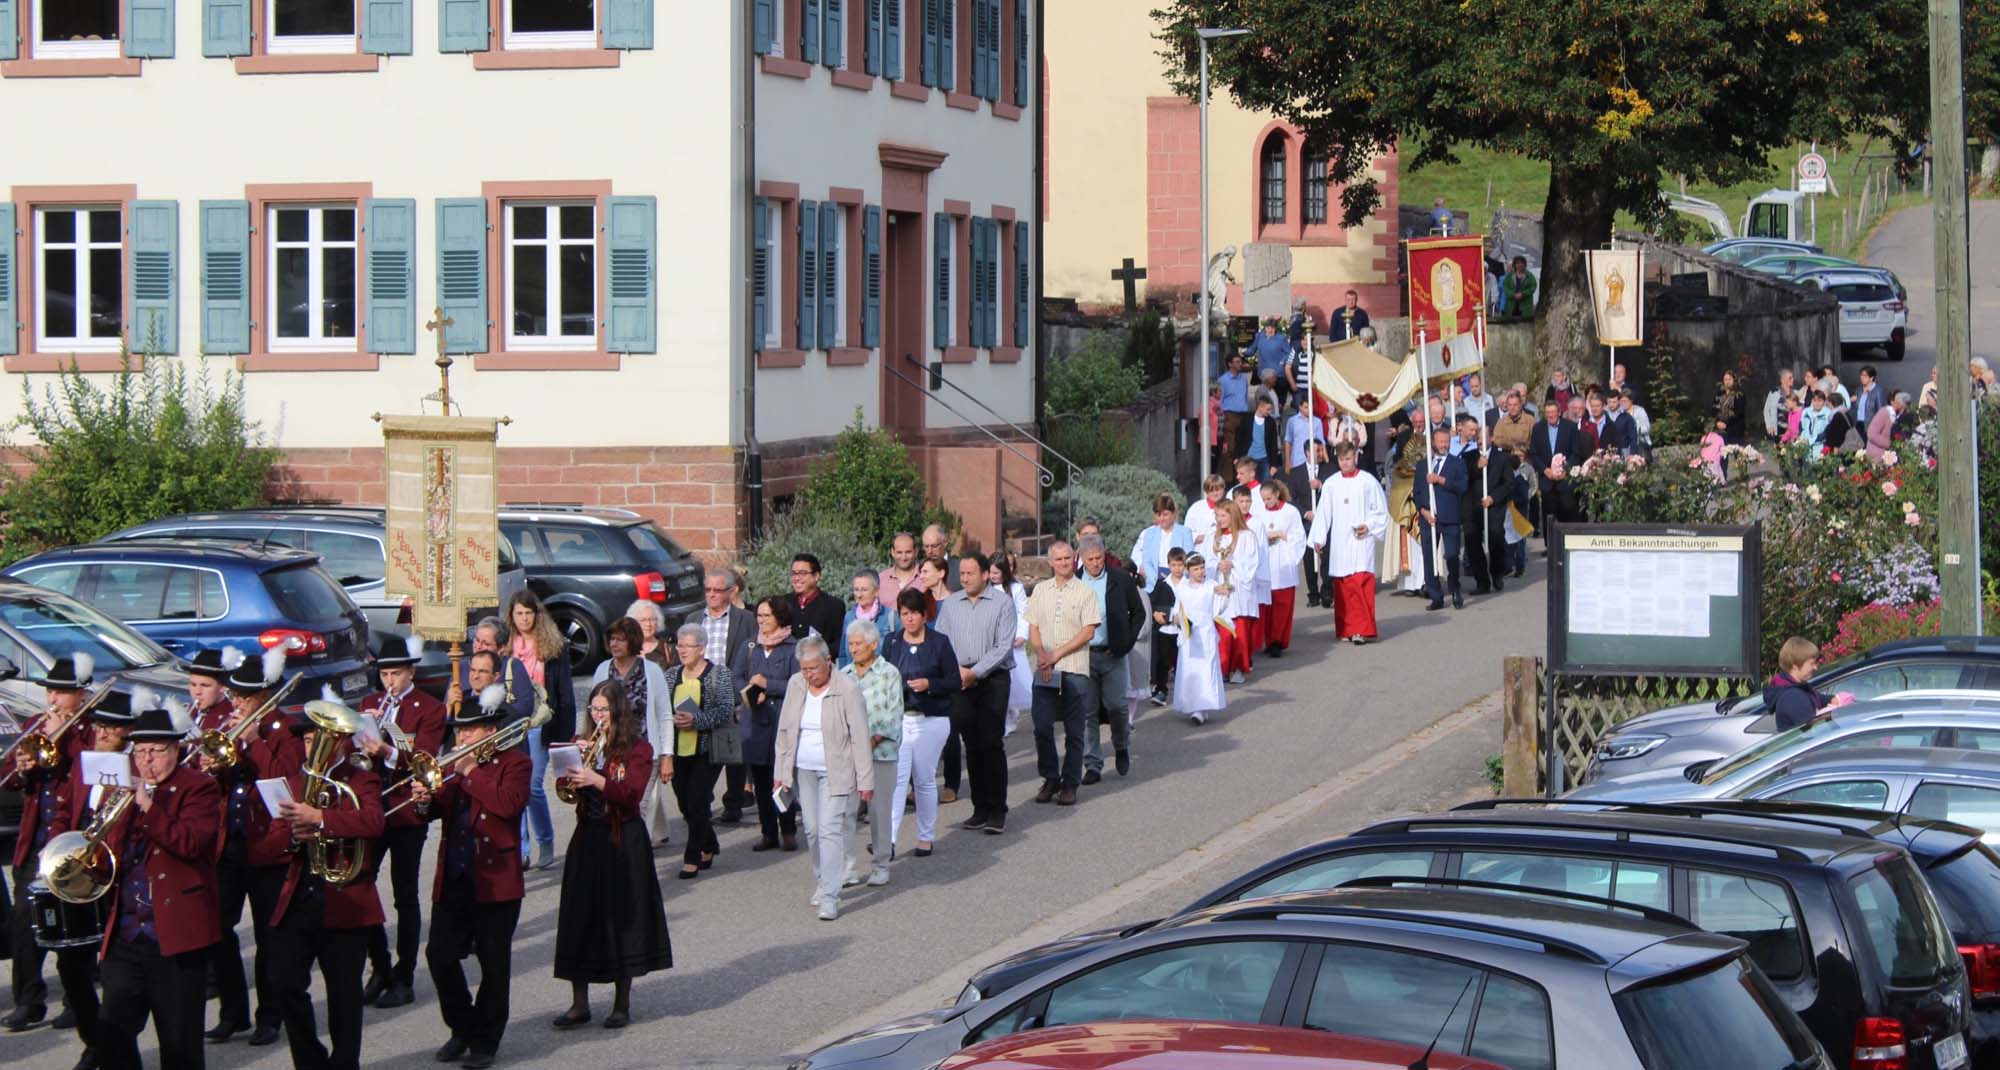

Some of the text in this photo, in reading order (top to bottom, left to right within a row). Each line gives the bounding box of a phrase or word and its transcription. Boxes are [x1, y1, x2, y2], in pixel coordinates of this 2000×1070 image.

[467, 536, 491, 561] BITTE
[1590, 538, 1719, 551] Amtl. Bekanntmachungen
[471, 570, 490, 588] UNS
